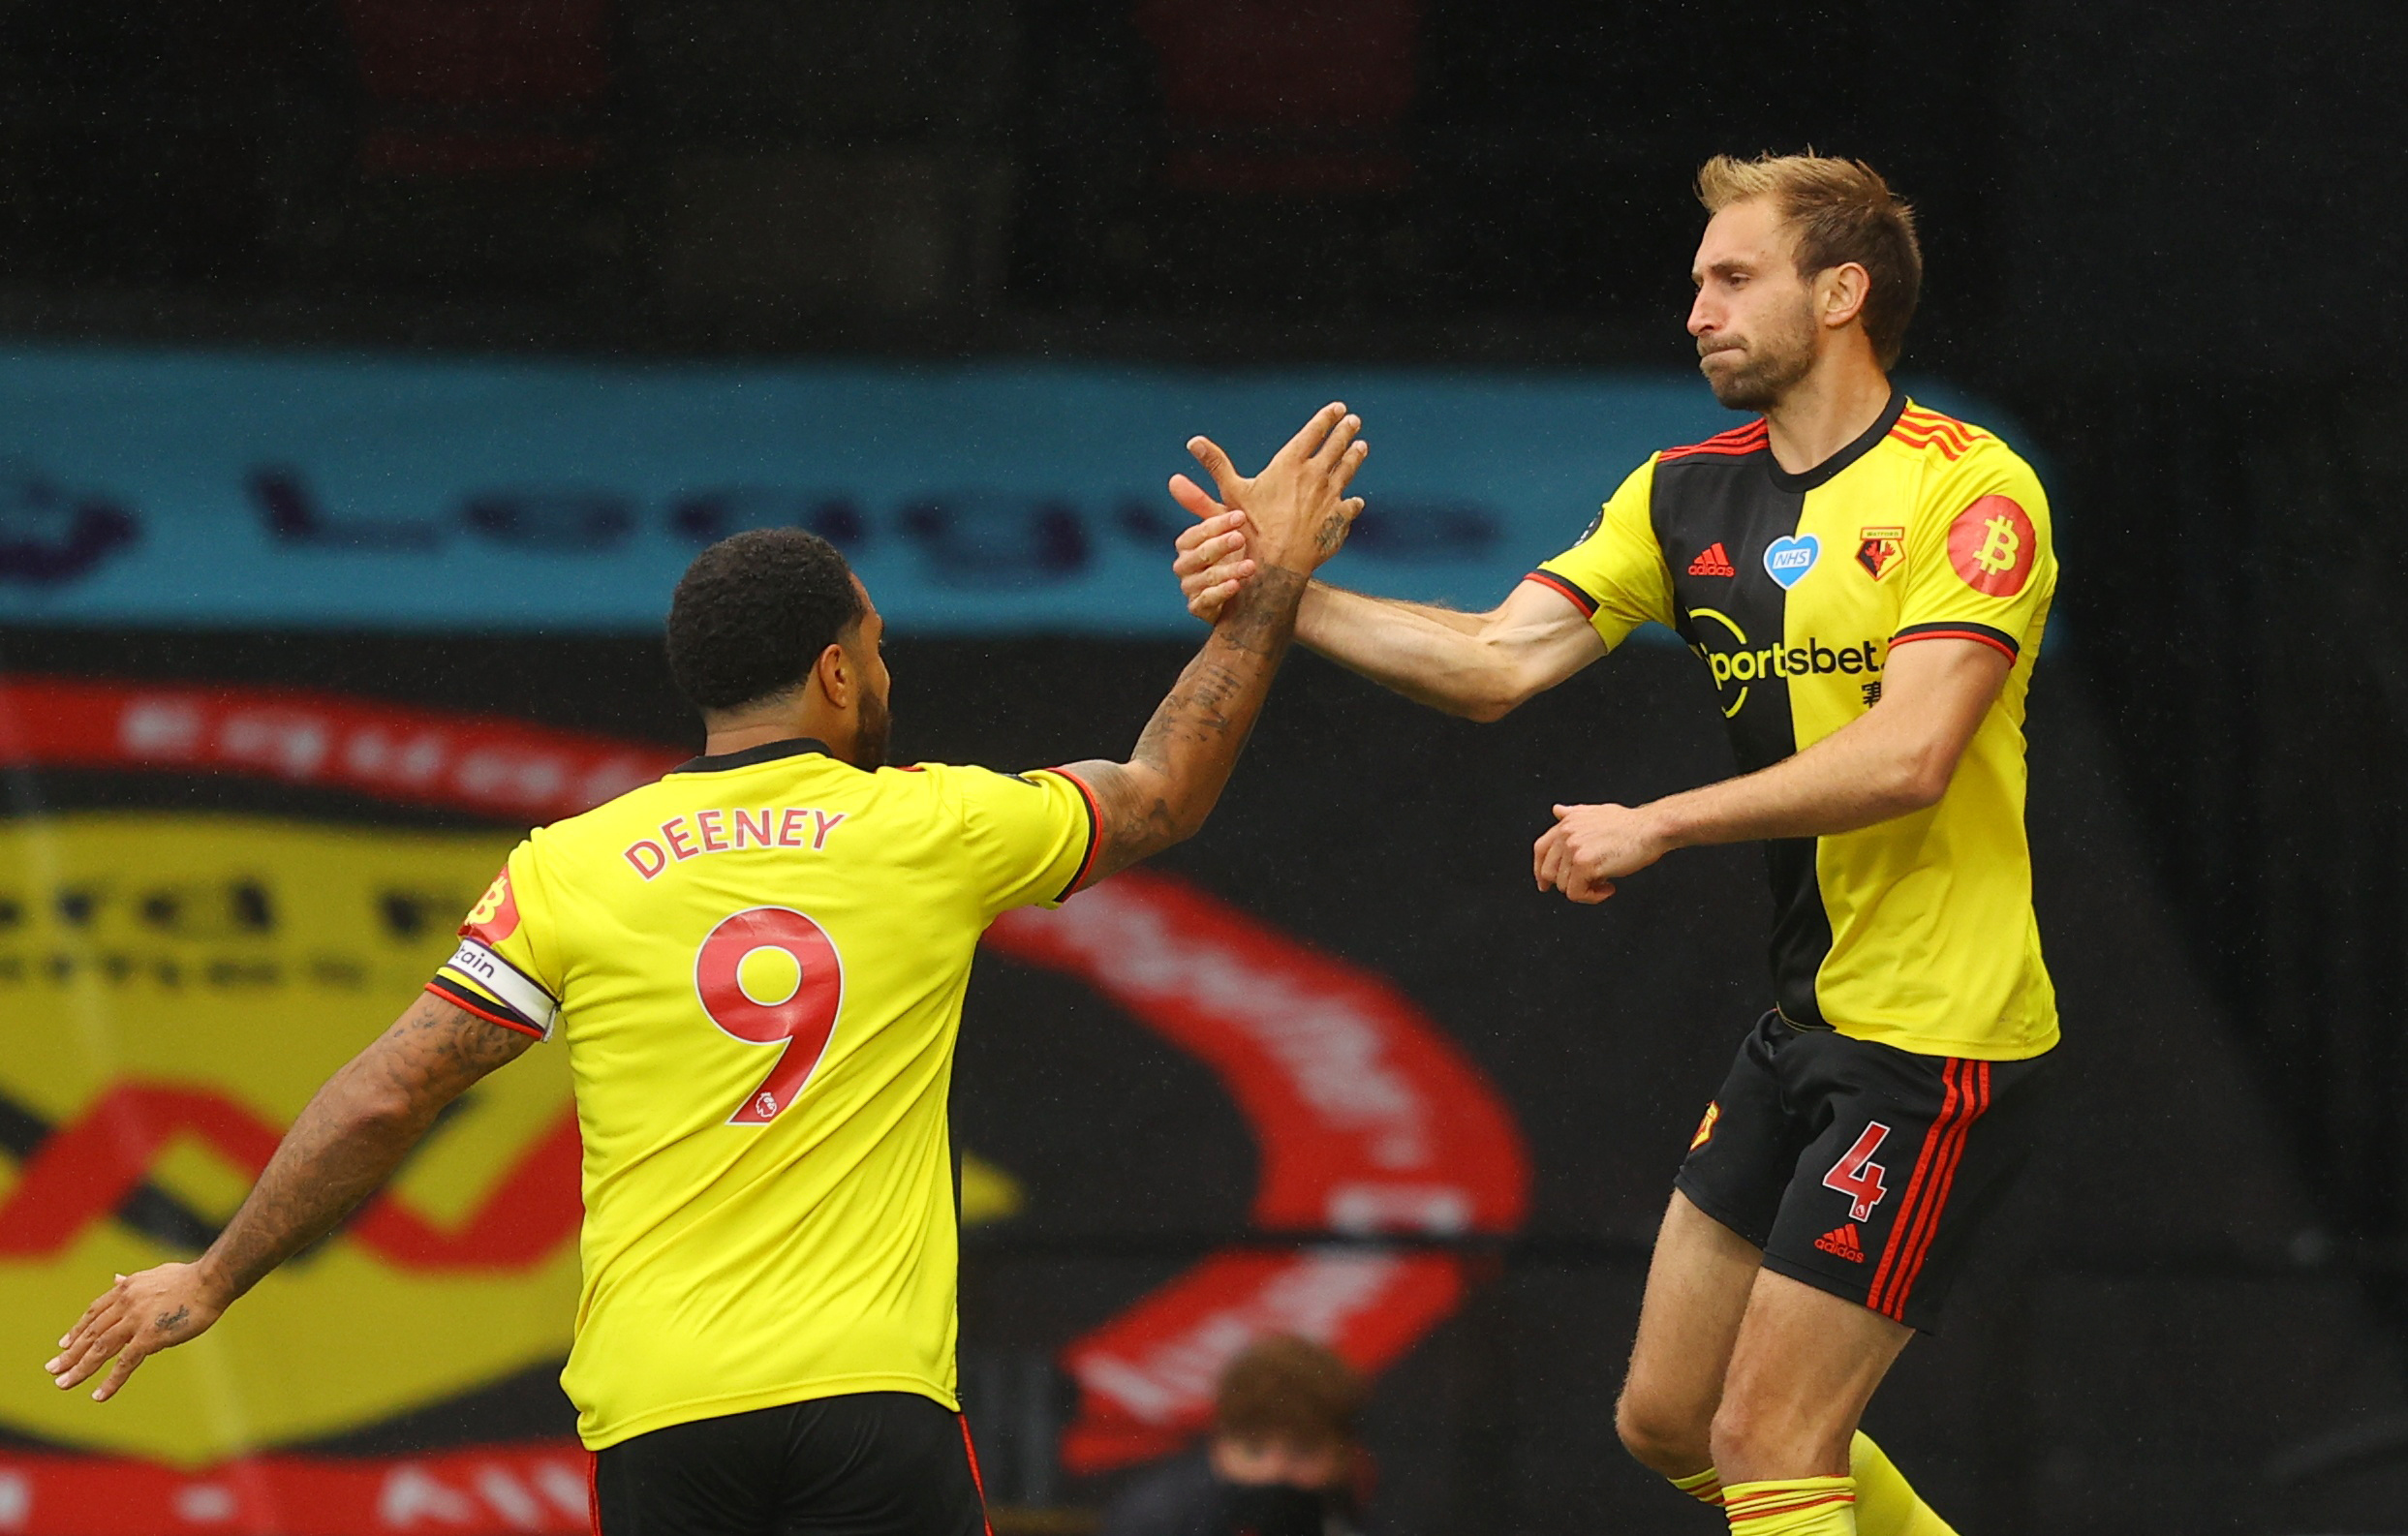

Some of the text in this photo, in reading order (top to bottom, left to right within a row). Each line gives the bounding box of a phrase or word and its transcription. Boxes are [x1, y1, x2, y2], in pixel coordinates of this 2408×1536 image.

[1688, 562, 1735, 577] adidas
[1775, 550, 1809, 566] NHS
[623, 809, 847, 880] DEENEY
[696, 906, 844, 1124] 9
[1822, 1120, 1891, 1223] 4
[1813, 1237, 1866, 1263] adidas
